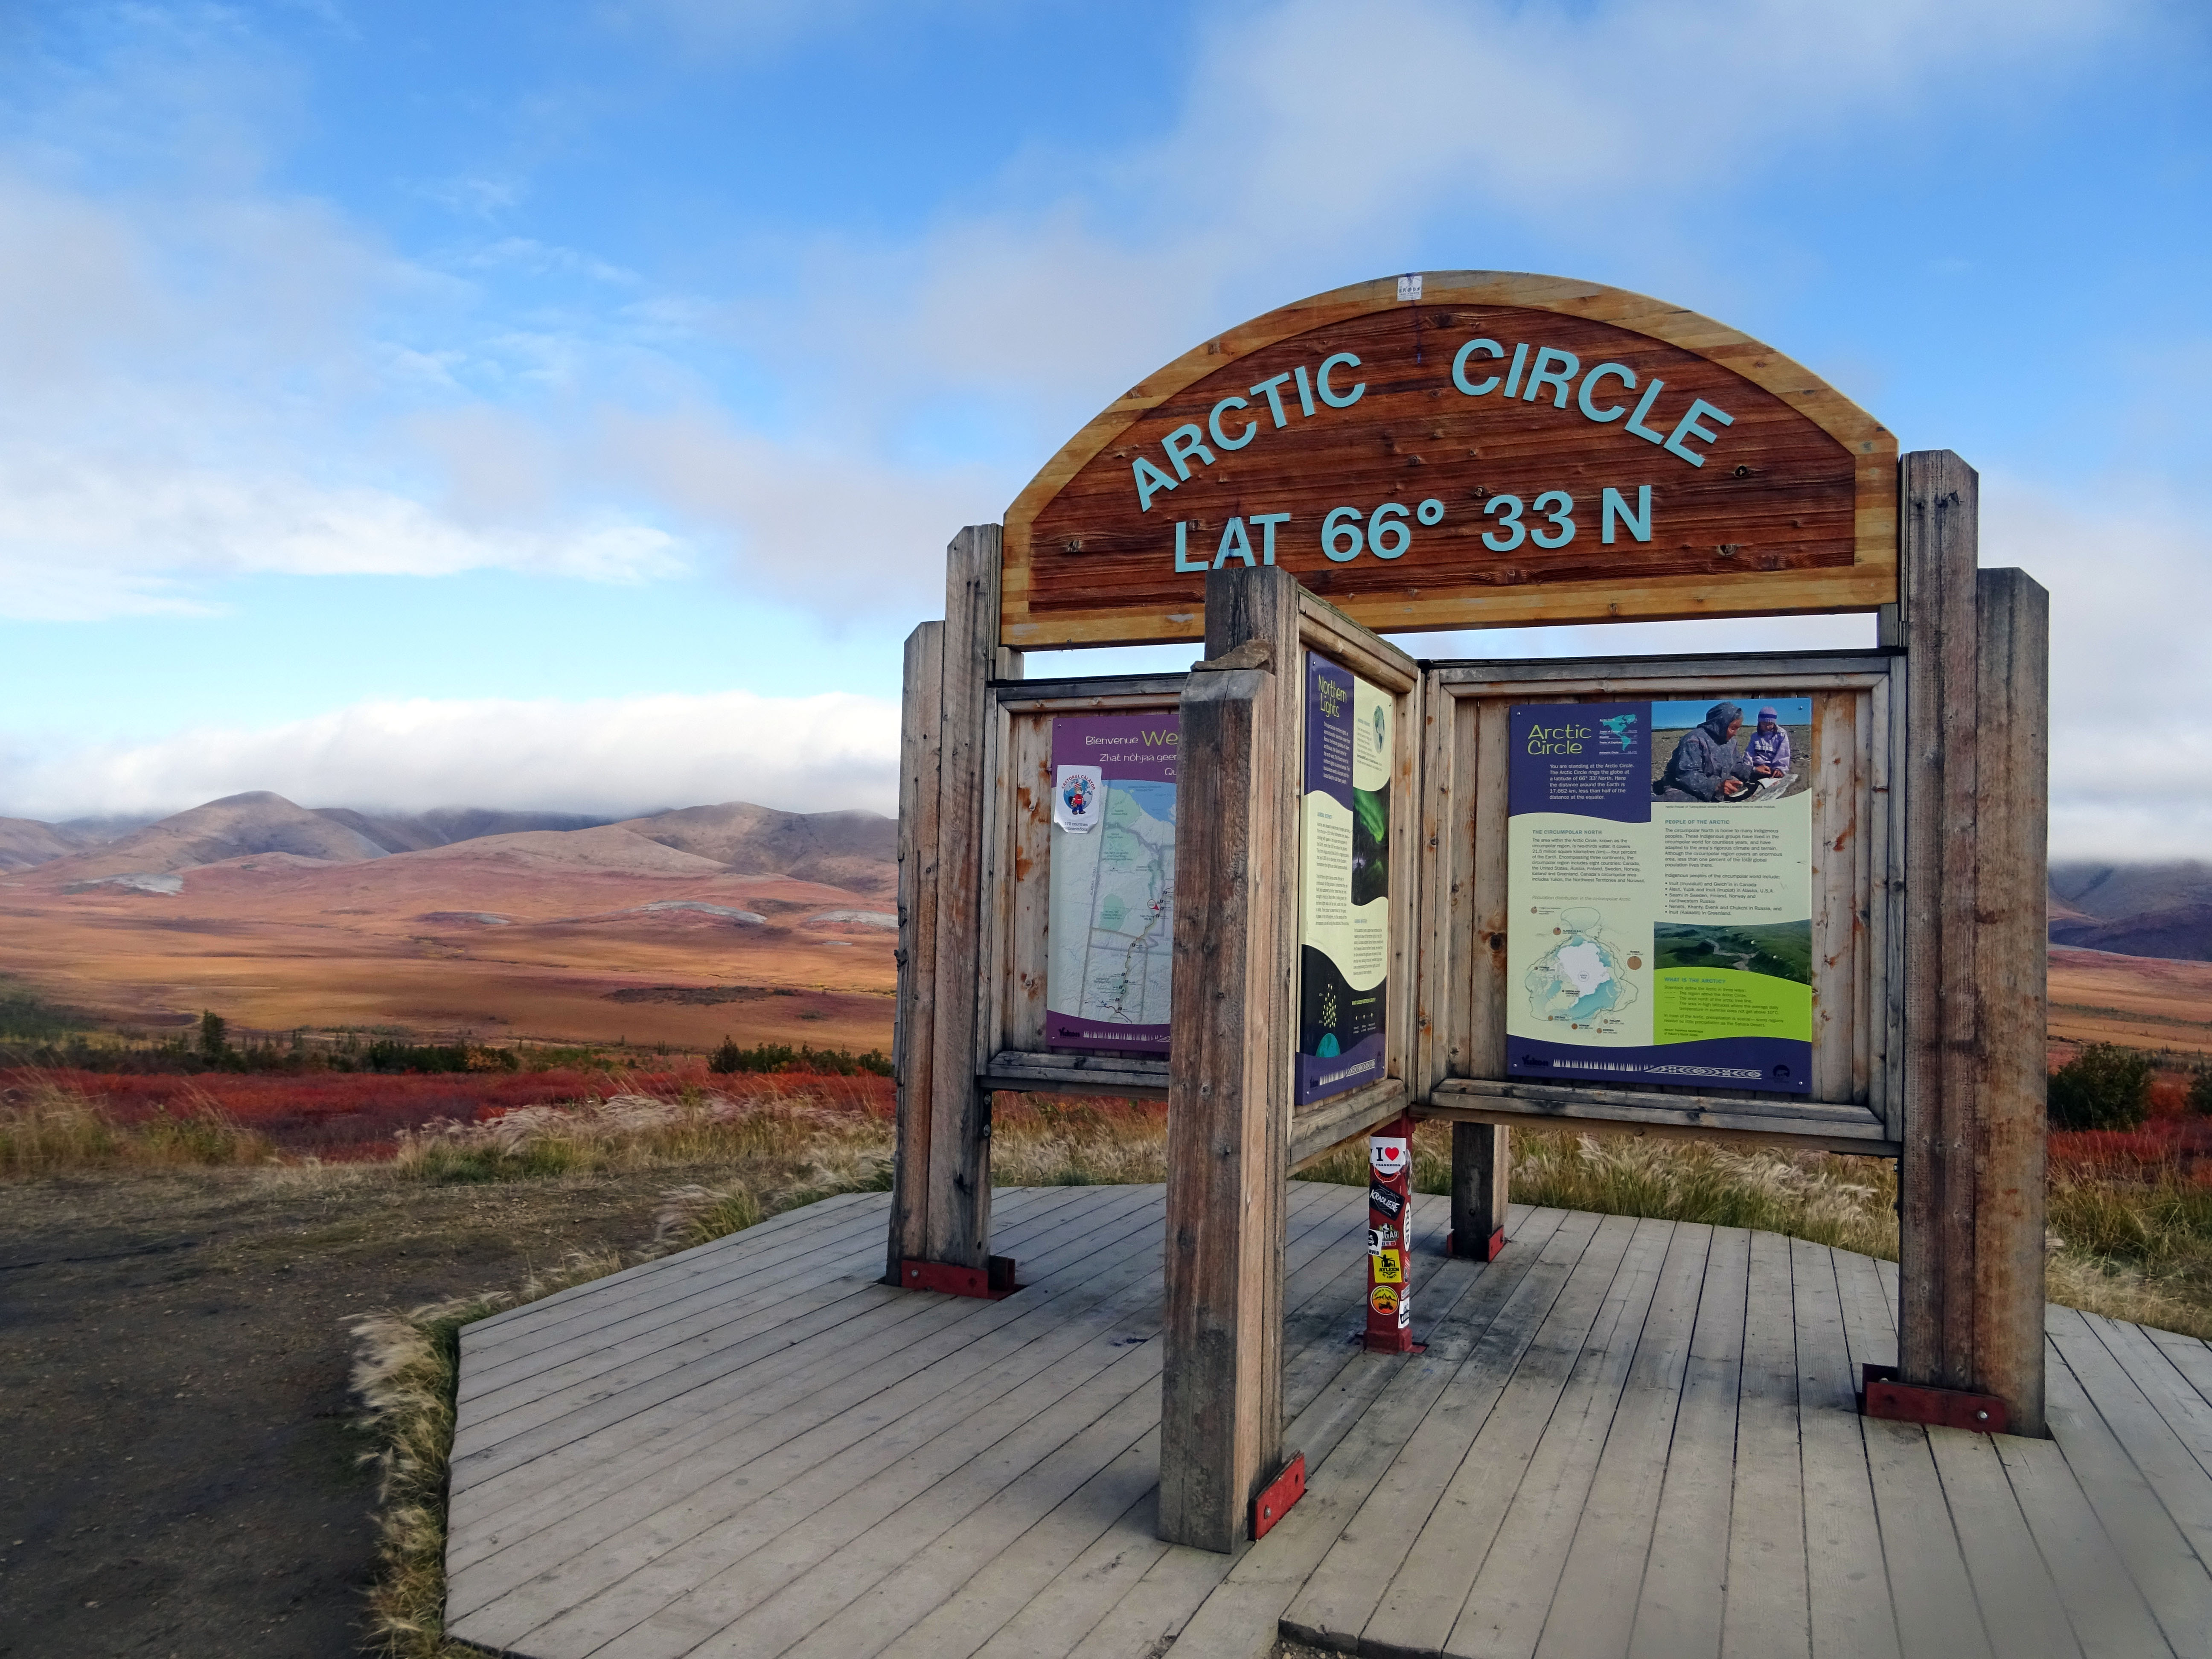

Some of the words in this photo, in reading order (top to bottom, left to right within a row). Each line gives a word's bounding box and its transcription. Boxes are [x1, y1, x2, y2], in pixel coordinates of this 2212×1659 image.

[1132, 352, 1365, 512] ARCTIC
[1452, 338, 1735, 468] CIRCLE
[1175, 513, 1290, 573] LAT
[1321, 498, 1444, 562] 66°
[1481, 491, 1576, 552] 33
[1602, 485, 1651, 544] N
[1318, 674, 1347, 704] Northern
[1320, 693, 1339, 718] Lights
[1086, 736, 1138, 745] Bienvenue
[1141, 730, 1178, 746] We
[1528, 724, 1592, 739] Arctic
[1527, 740, 1582, 755] Circle
[1099, 754, 1121, 762] Zhat
[1061, 774, 1080, 789] CASTORUL
[1376, 1147, 1383, 1161] I
[1370, 1189, 1400, 1213] KRADLIEBE
